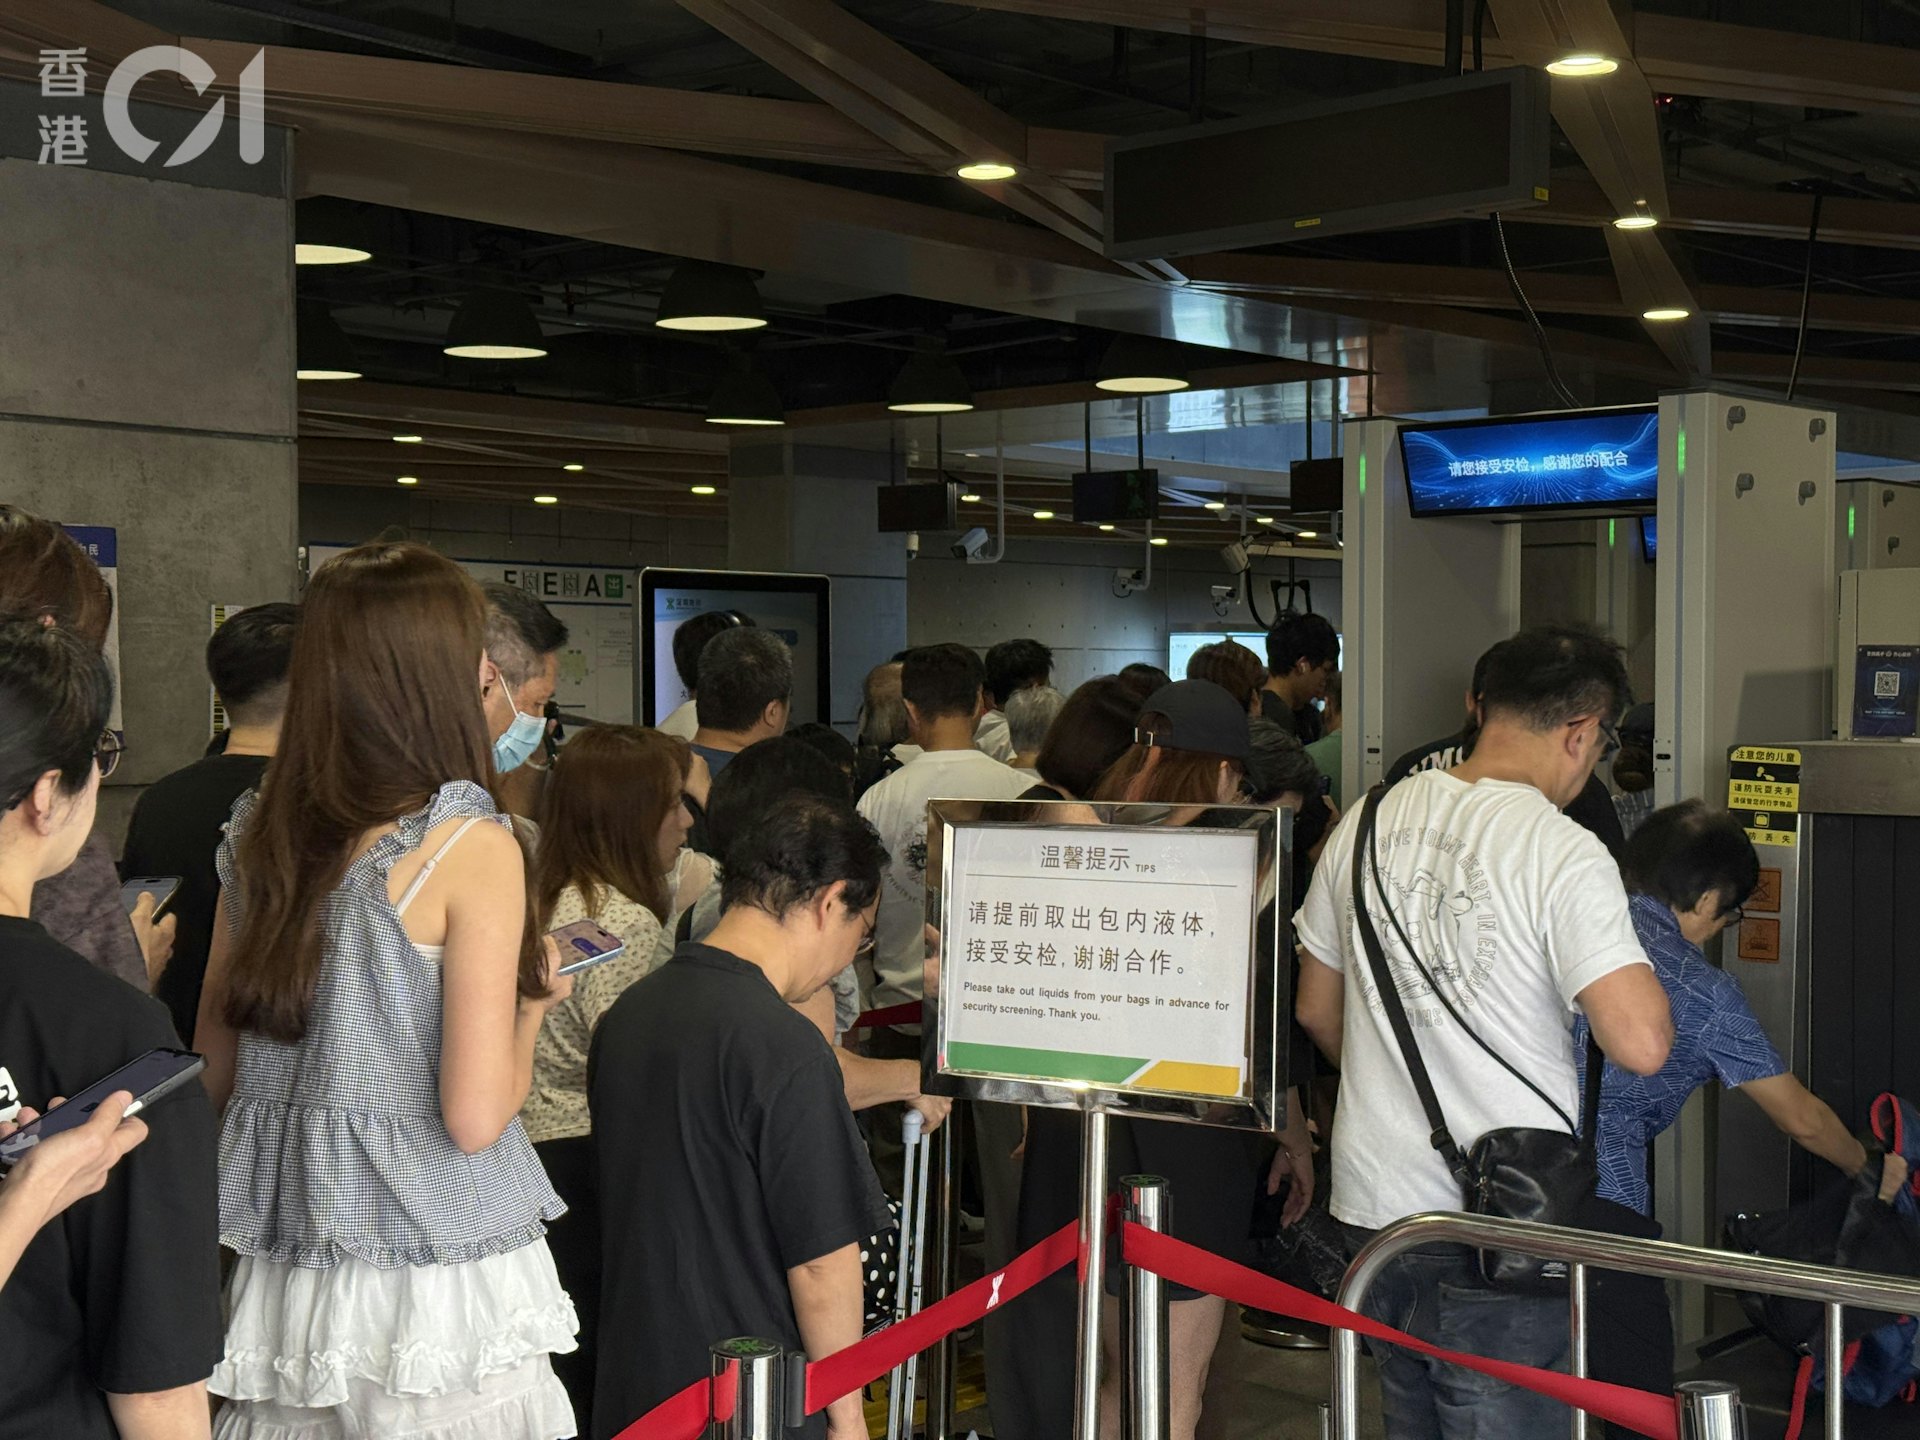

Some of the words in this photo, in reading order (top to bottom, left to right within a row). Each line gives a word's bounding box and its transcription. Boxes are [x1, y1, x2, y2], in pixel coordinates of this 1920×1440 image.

[1448, 451, 1629, 477] 请您接受安检，感谢您的配合
[543, 572, 558, 596] E
[584, 574, 601, 597] A
[1736, 749, 1796, 763] 注意您的儿童
[1040, 844, 1131, 872] 温馨提示
[1135, 863, 1156, 873] TIPS
[968, 900, 1216, 938] 请提前取出包内液体，
[1477, 913, 1497, 932] IN
[966, 937, 1186, 976] 接受安检，谢谢合作。
[963, 981, 993, 993] Please
[996, 984, 1016, 995] take
[1019, 987, 1035, 997] out
[1038, 987, 1070, 1001] liquids
[1074, 989, 1096, 1001] from
[1100, 993, 1123, 1004] your
[1126, 993, 1151, 1006] bags
[1155, 995, 1164, 1006] in
[1168, 997, 1210, 1010] advance
[1214, 1000, 1230, 1011] for
[962, 1001, 998, 1015] security
[999, 1005, 1046, 1018] screening.
[1048, 1007, 1077, 1019] Thank
[1080, 1011, 1101, 1022] you.
